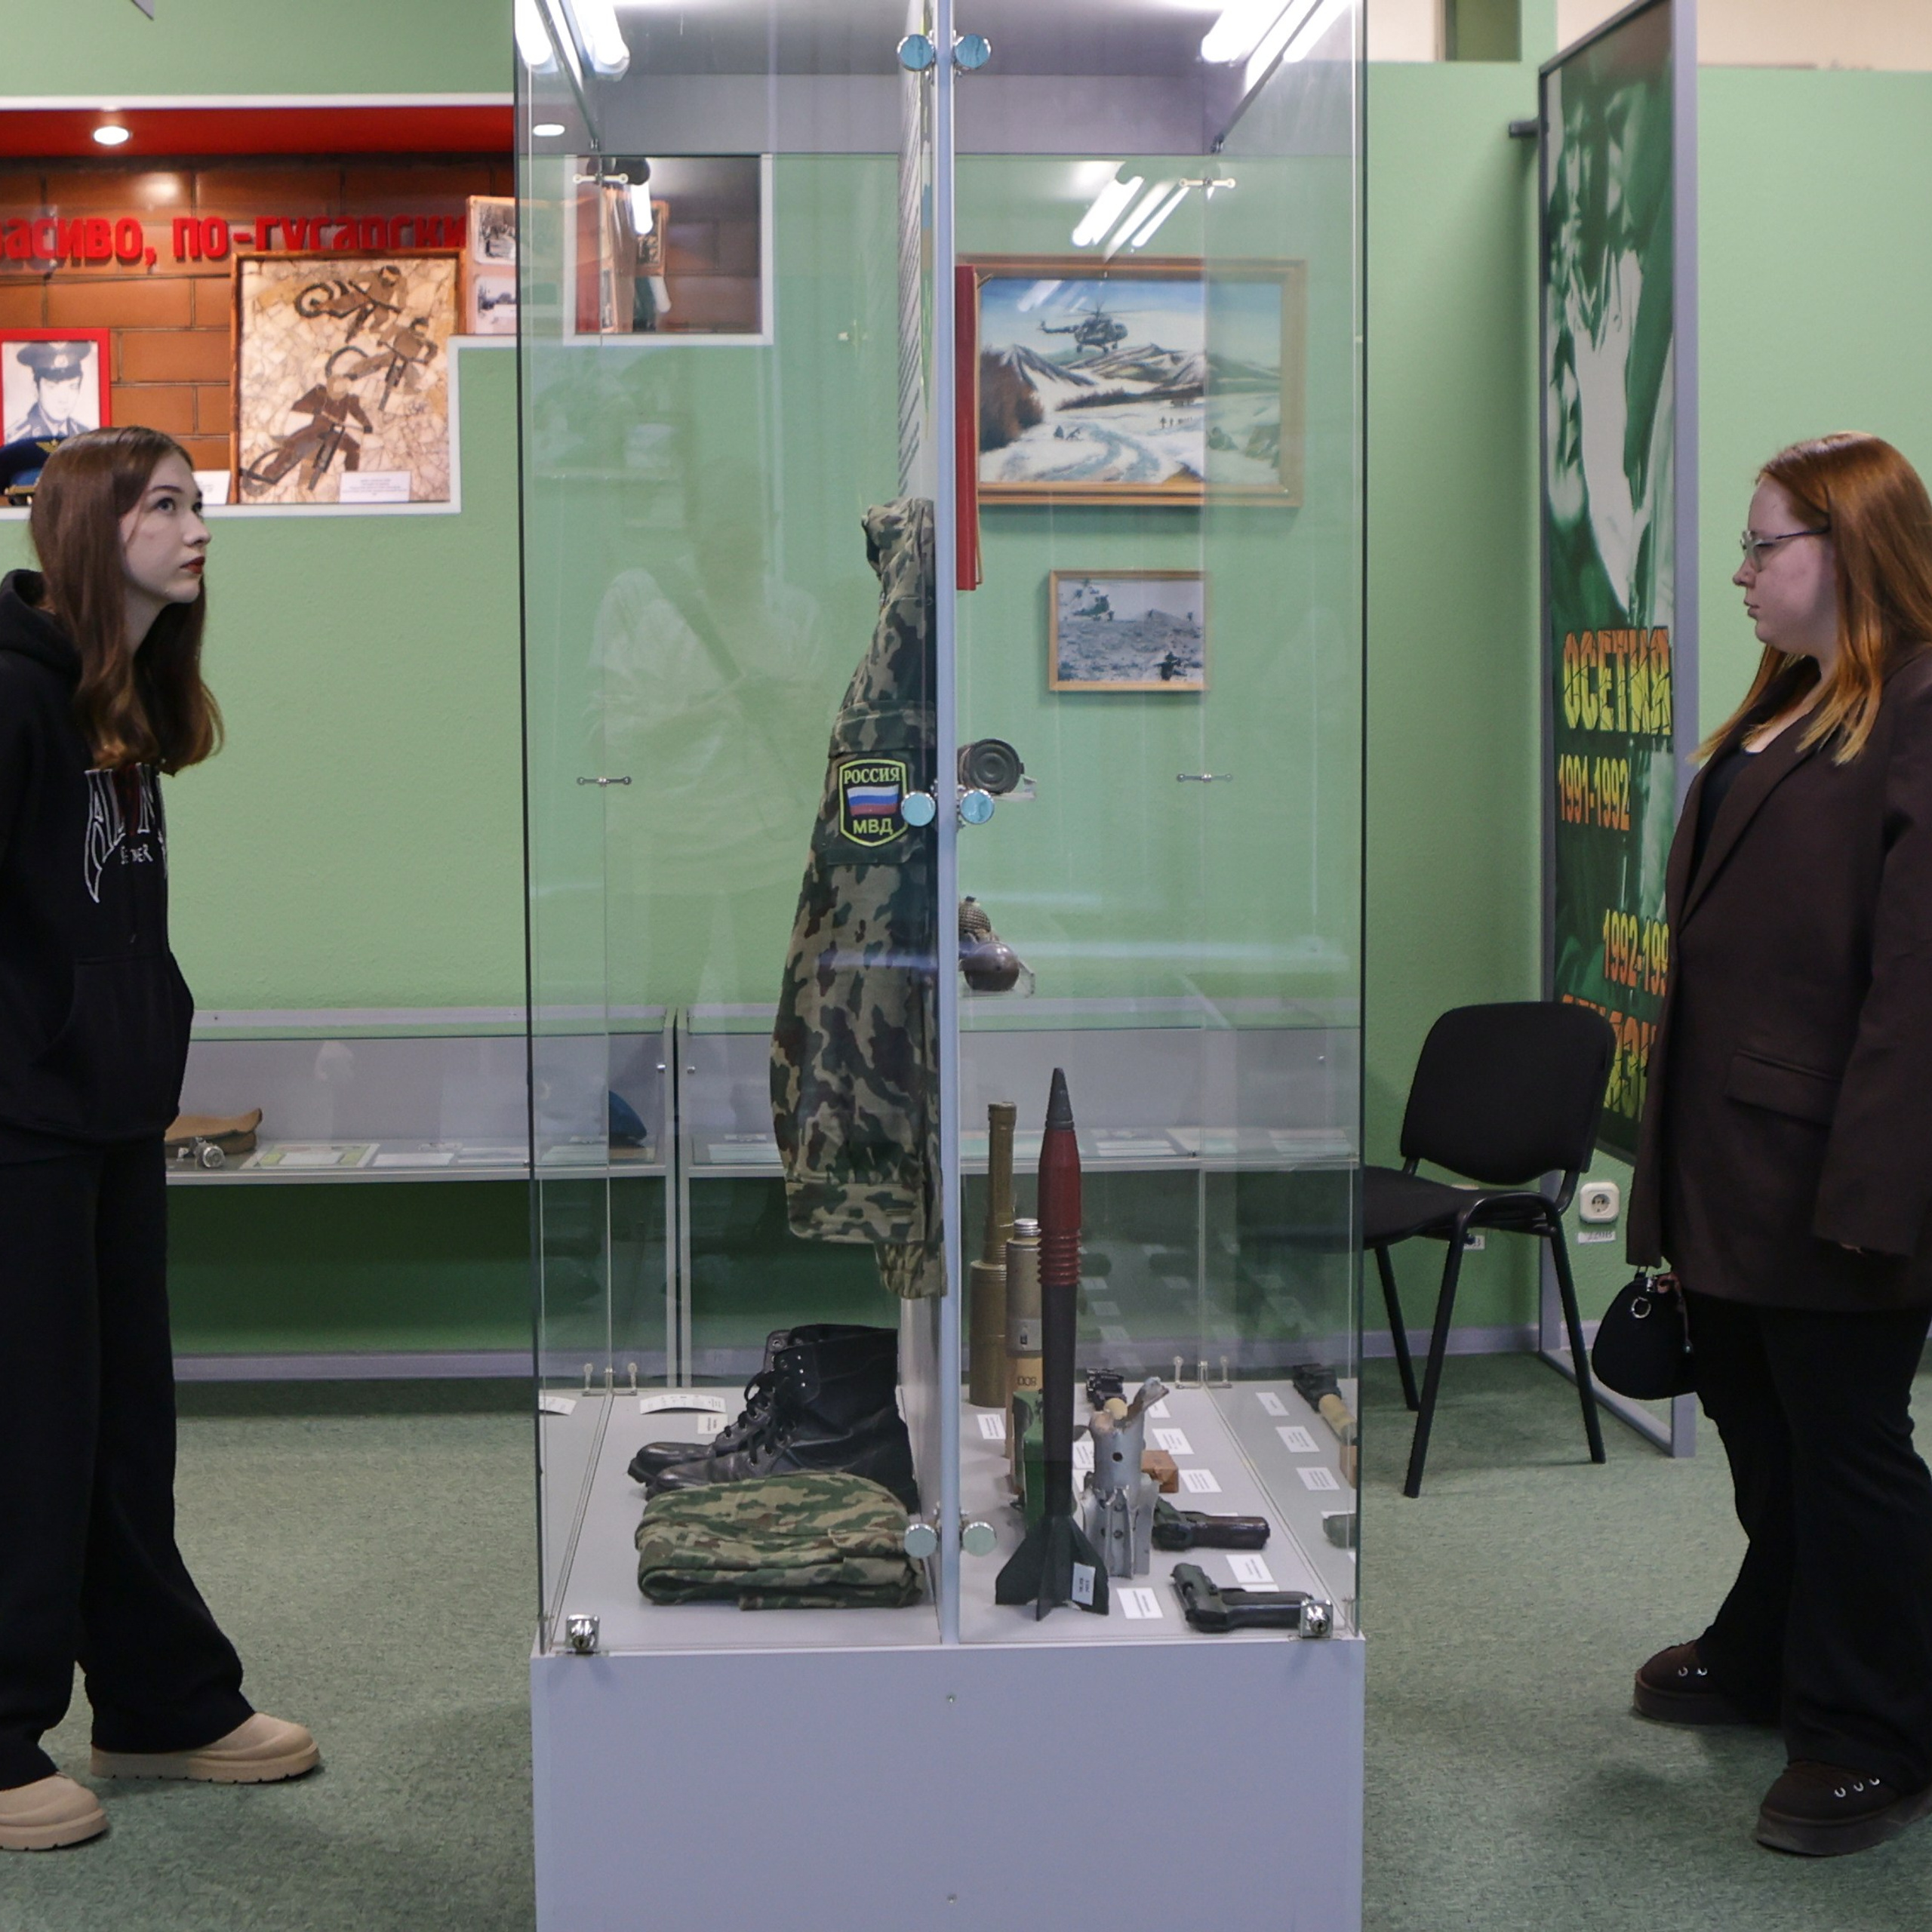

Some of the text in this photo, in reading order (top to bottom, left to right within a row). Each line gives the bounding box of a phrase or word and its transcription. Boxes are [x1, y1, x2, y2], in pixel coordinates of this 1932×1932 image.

[0, 216, 157, 266] асиво,
[1563, 628, 1672, 736] ОСЕТИЯ
[843, 767, 901, 785] РОССИЯ
[1558, 753, 1630, 831] 1991-1992
[852, 817, 894, 835] МВД
[1602, 908, 1669, 998] 1992-199
